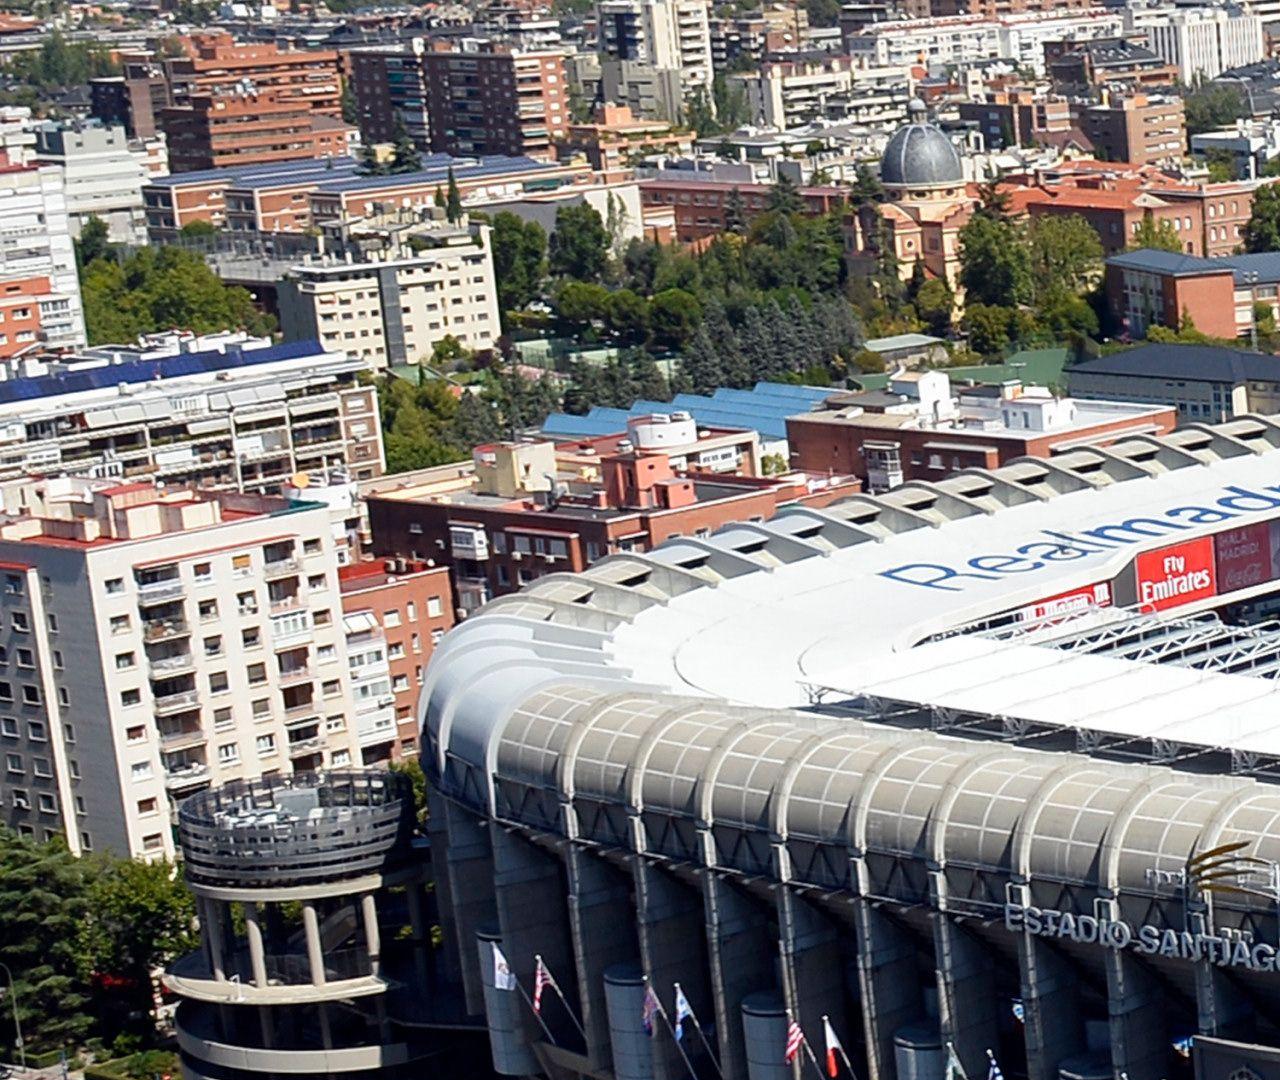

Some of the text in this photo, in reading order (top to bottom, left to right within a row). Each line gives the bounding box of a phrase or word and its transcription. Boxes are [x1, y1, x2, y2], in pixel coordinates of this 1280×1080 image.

[1164, 557, 1184, 573] Fly
[1142, 570, 1210, 603] Emirates
[1004, 904, 1130, 950] ESTADIO
